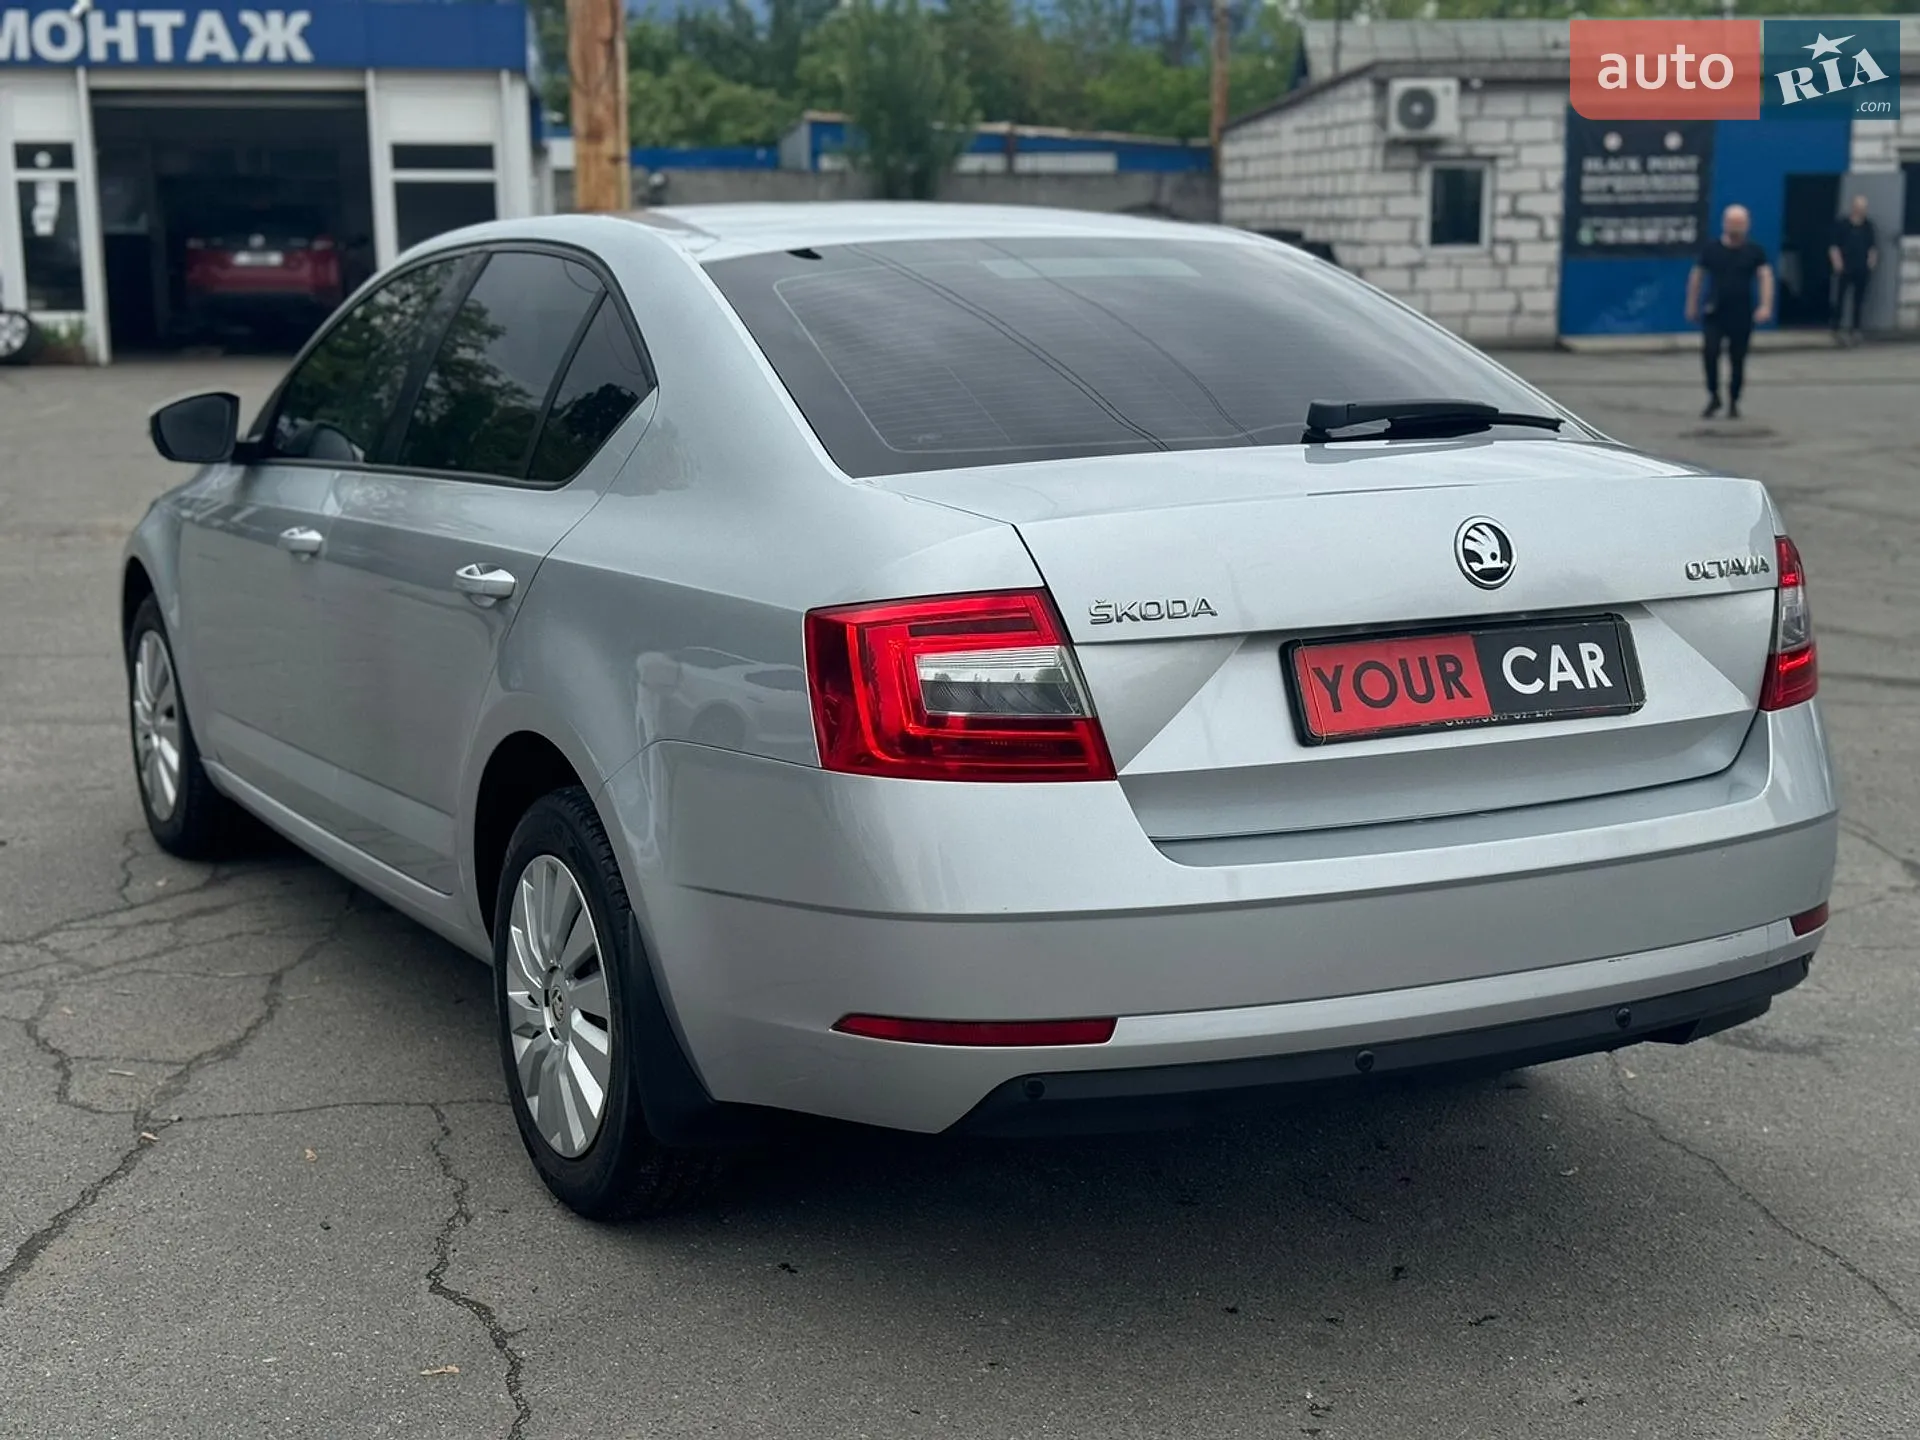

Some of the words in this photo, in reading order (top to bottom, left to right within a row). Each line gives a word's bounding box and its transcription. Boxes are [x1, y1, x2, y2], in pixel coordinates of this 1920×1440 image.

[1685, 556, 1770, 580] OCTAVIA
[1089, 598, 1218, 625] ŠKODA
[1312, 654, 1473, 713] YOUR
[1502, 642, 1614, 695] CAR
